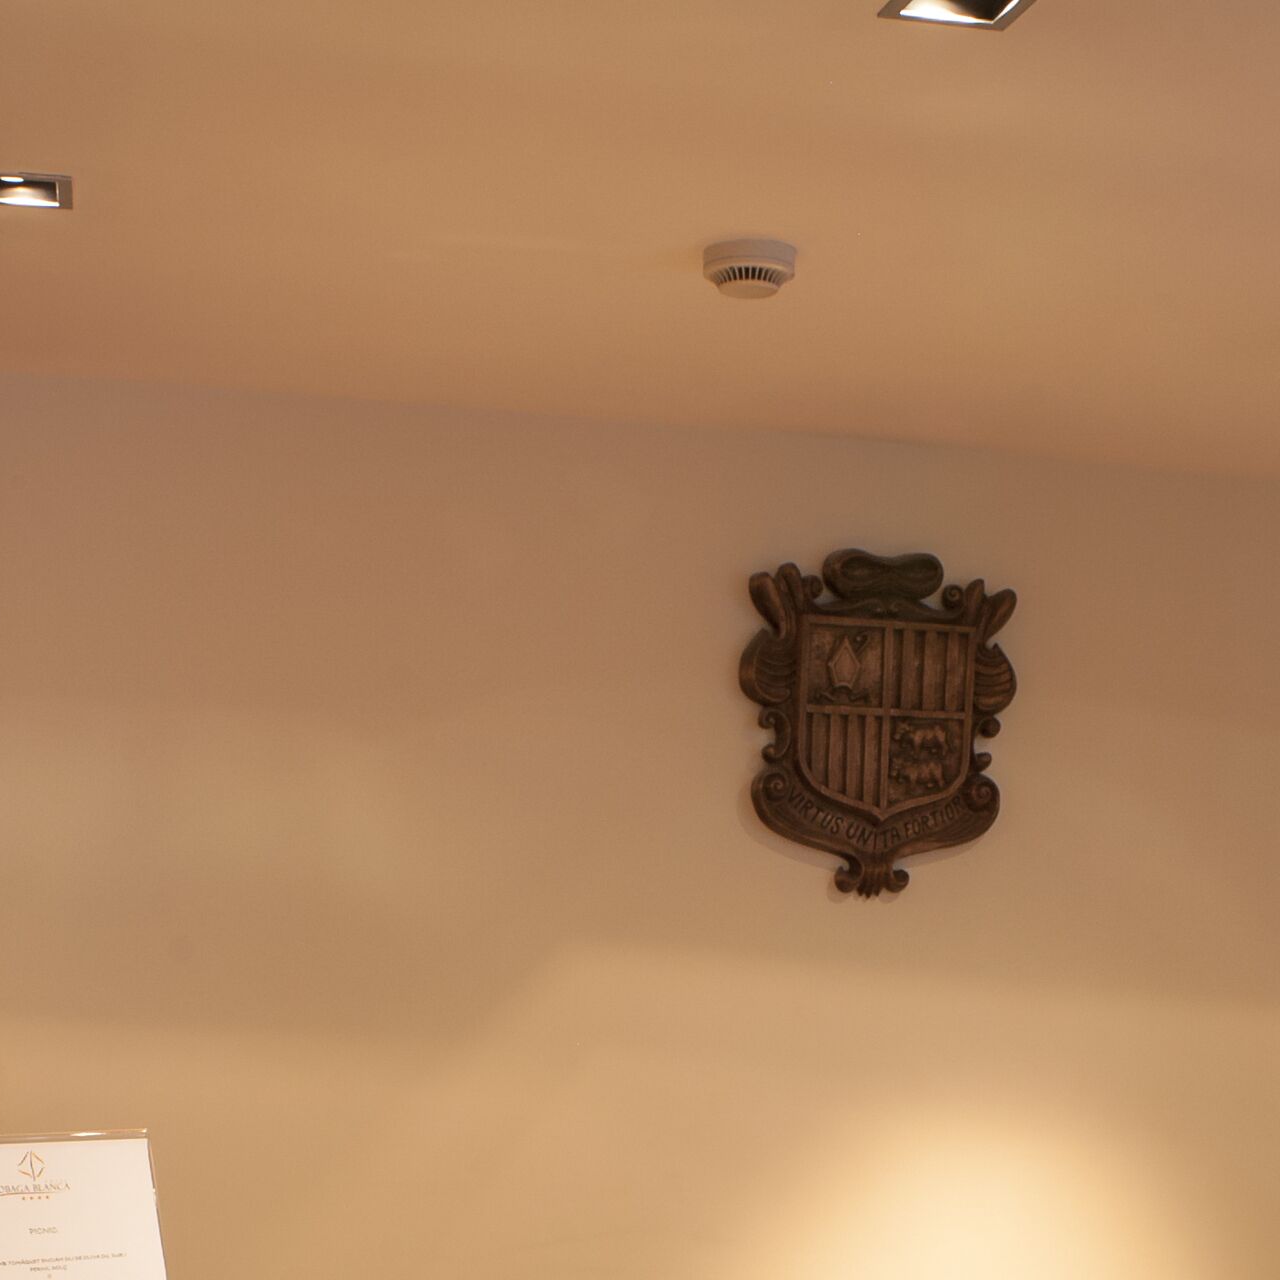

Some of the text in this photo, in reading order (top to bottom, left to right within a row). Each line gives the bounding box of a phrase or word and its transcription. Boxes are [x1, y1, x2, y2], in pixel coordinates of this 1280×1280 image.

[788, 787, 963, 850] VIRTUS UNITA FORTIOR
[32, 1181, 70, 1193] BLANCA
